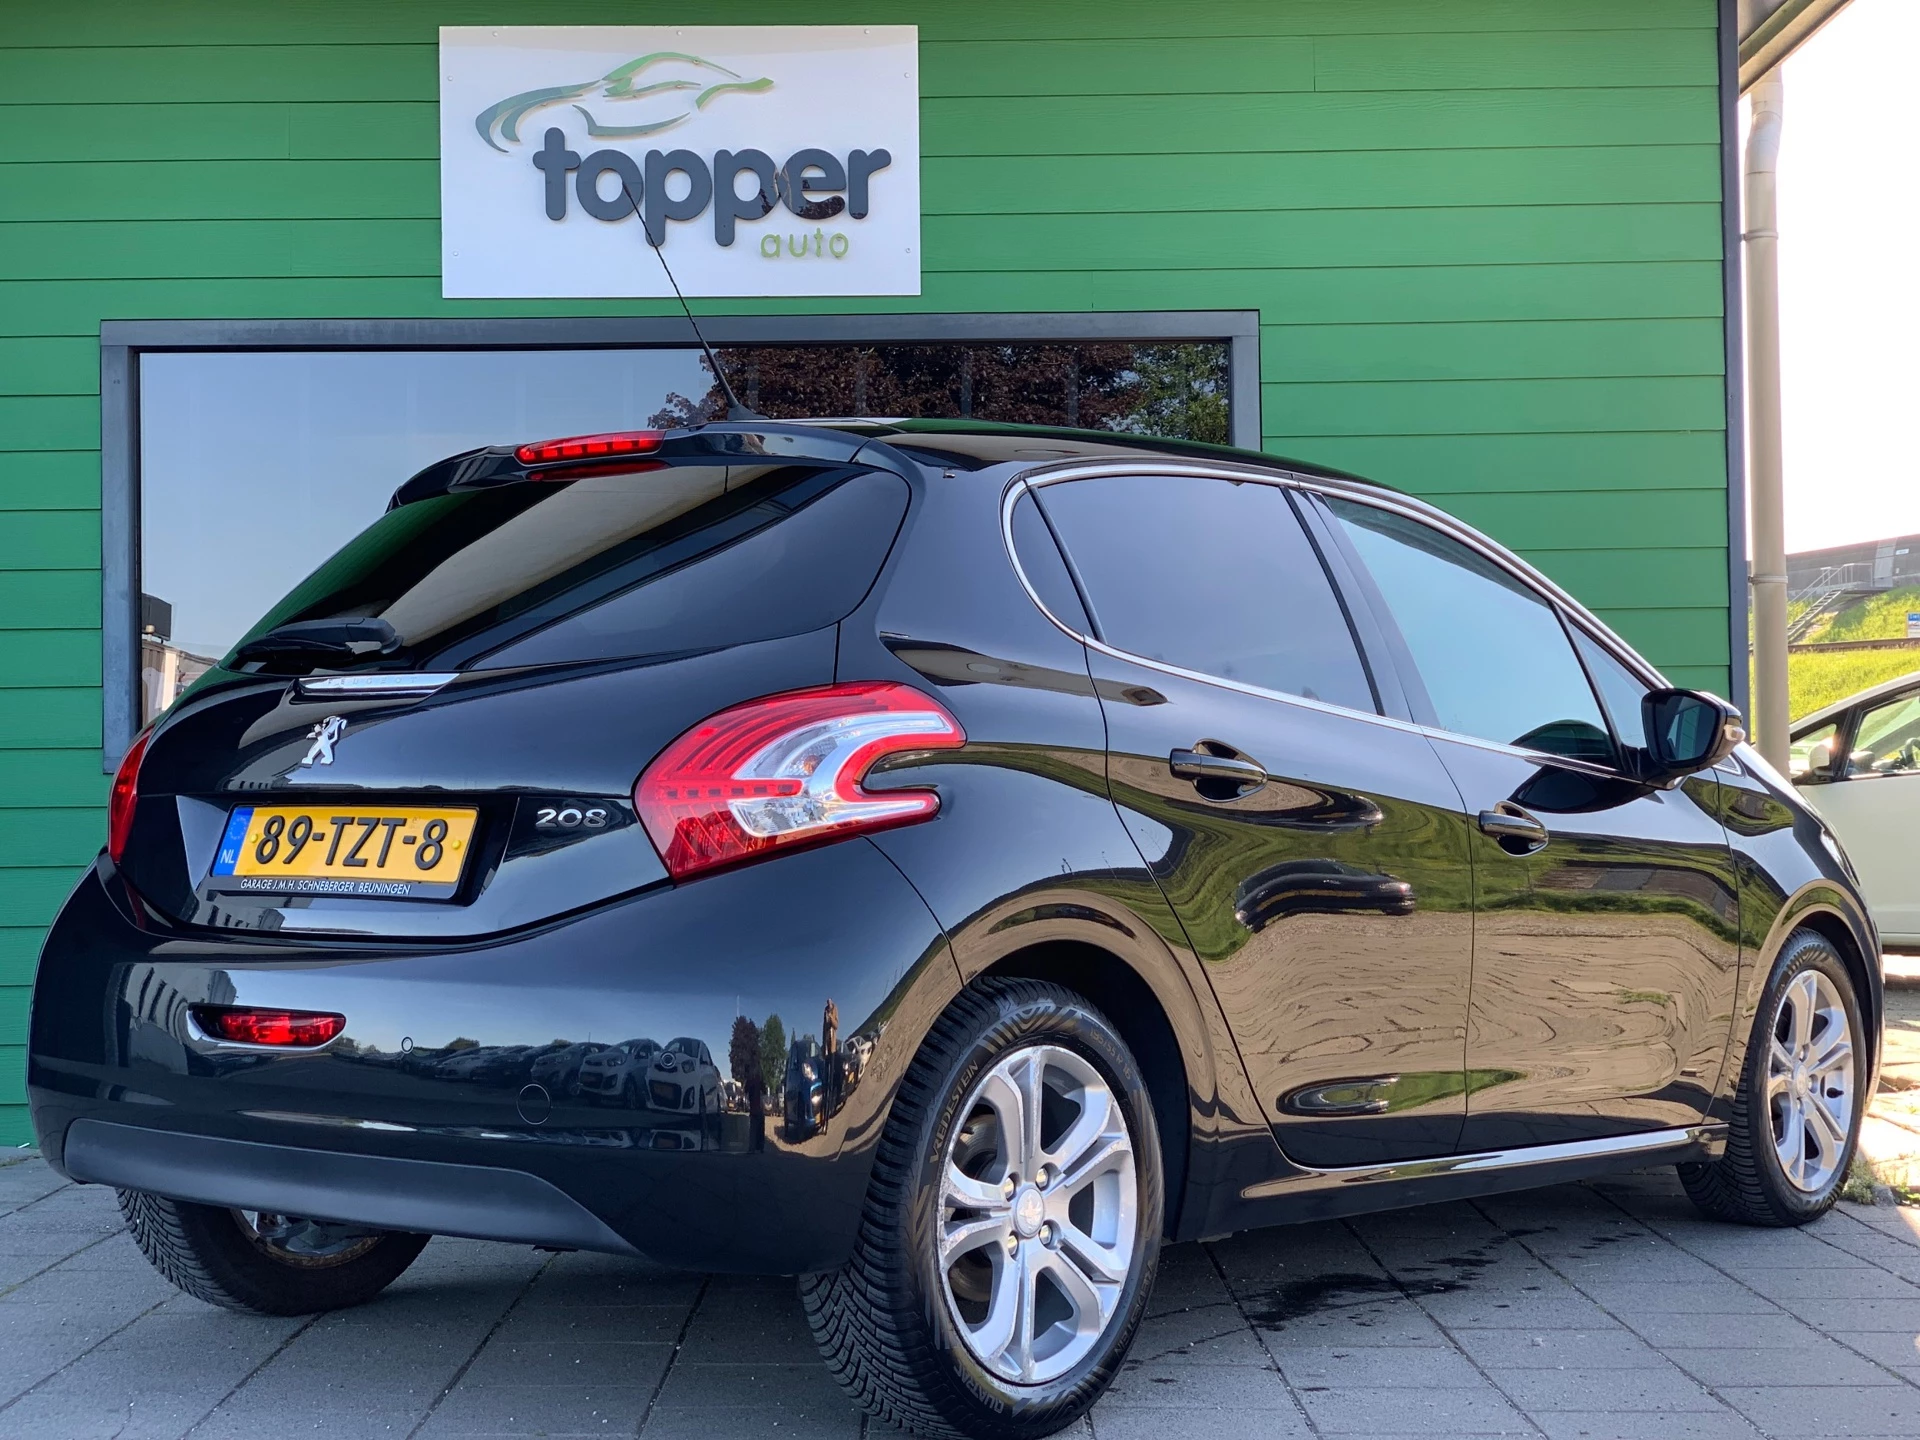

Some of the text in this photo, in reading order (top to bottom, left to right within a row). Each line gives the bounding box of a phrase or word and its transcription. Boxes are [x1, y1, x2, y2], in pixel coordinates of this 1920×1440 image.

[532, 127, 892, 248] topper
[760, 227, 849, 258] auto
[535, 808, 607, 828] 208
[220, 849, 235, 864] NL
[255, 815, 448, 871] 89-TZT-8
[240, 878, 272, 890] GARAGE
[297, 880, 355, 893] SCHNEBERGER
[358, 882, 411, 895] BEUNINGEN
[929, 1060, 979, 1163] VREDESTEIN
[953, 1364, 1005, 1414] QUATRAC
